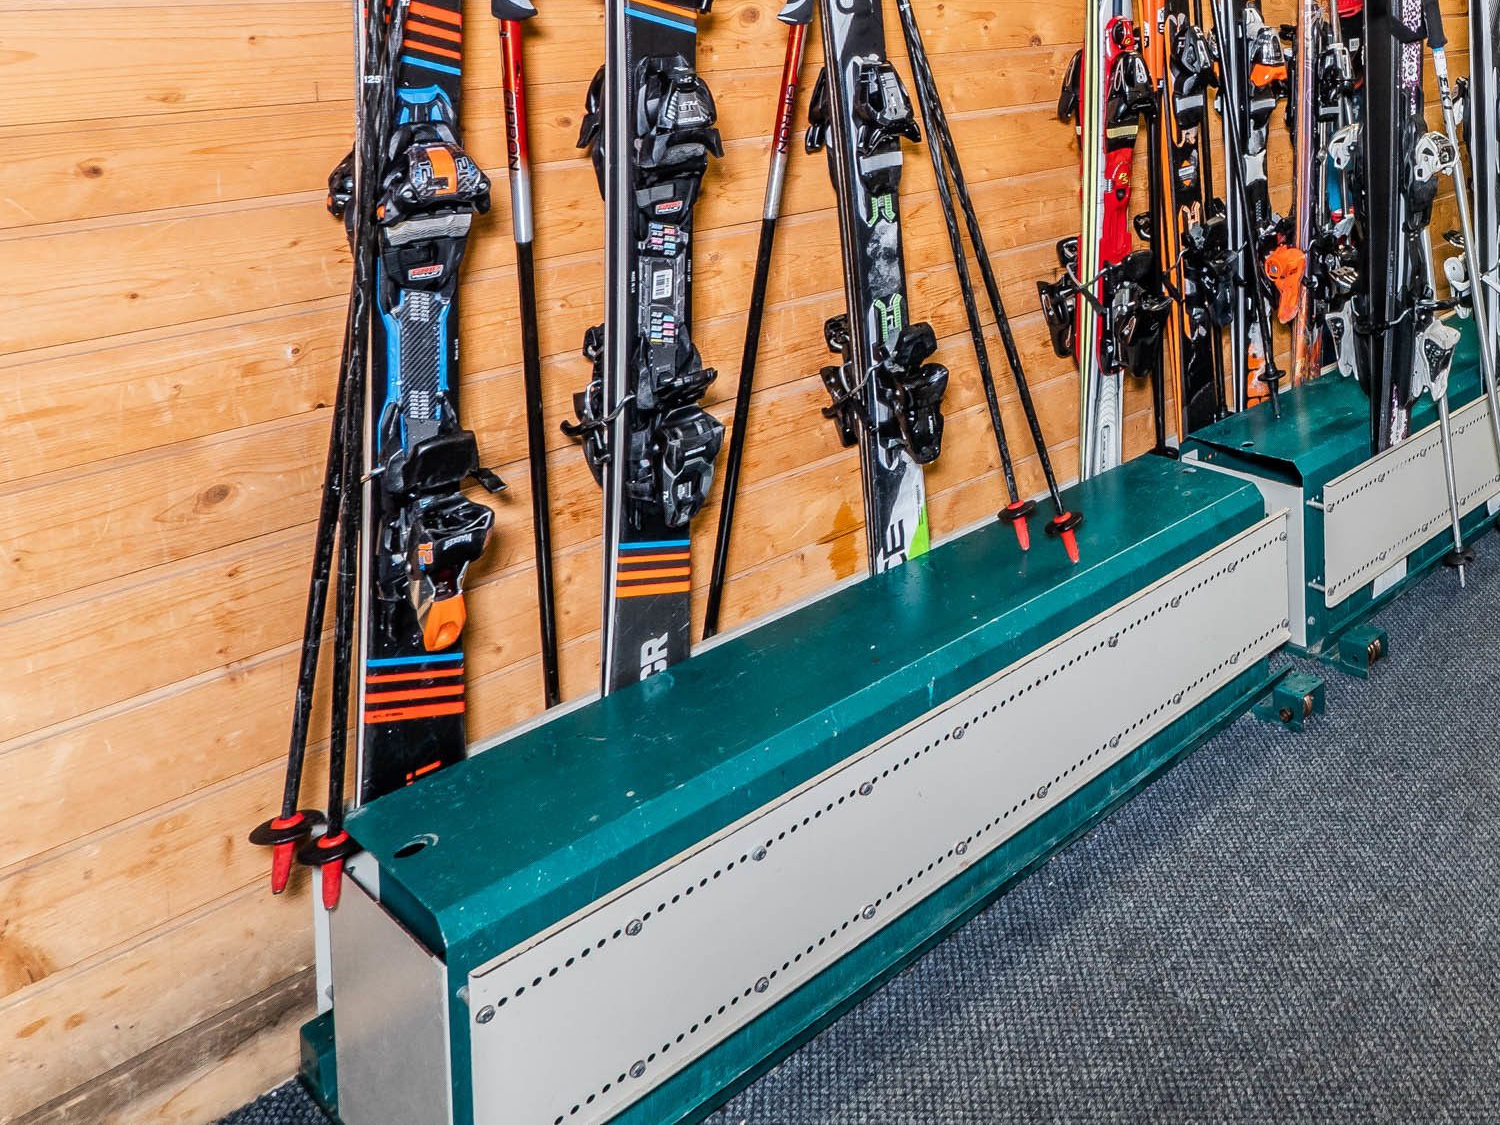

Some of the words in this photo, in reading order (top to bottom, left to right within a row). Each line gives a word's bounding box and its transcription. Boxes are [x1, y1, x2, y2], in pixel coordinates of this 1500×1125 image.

[363, 75, 383, 84] 125
[1439, 75, 1453, 110] EKI
[503, 89, 521, 172] GIPRON
[777, 82, 797, 155] GIPRON
[639, 632, 669, 682] CR
